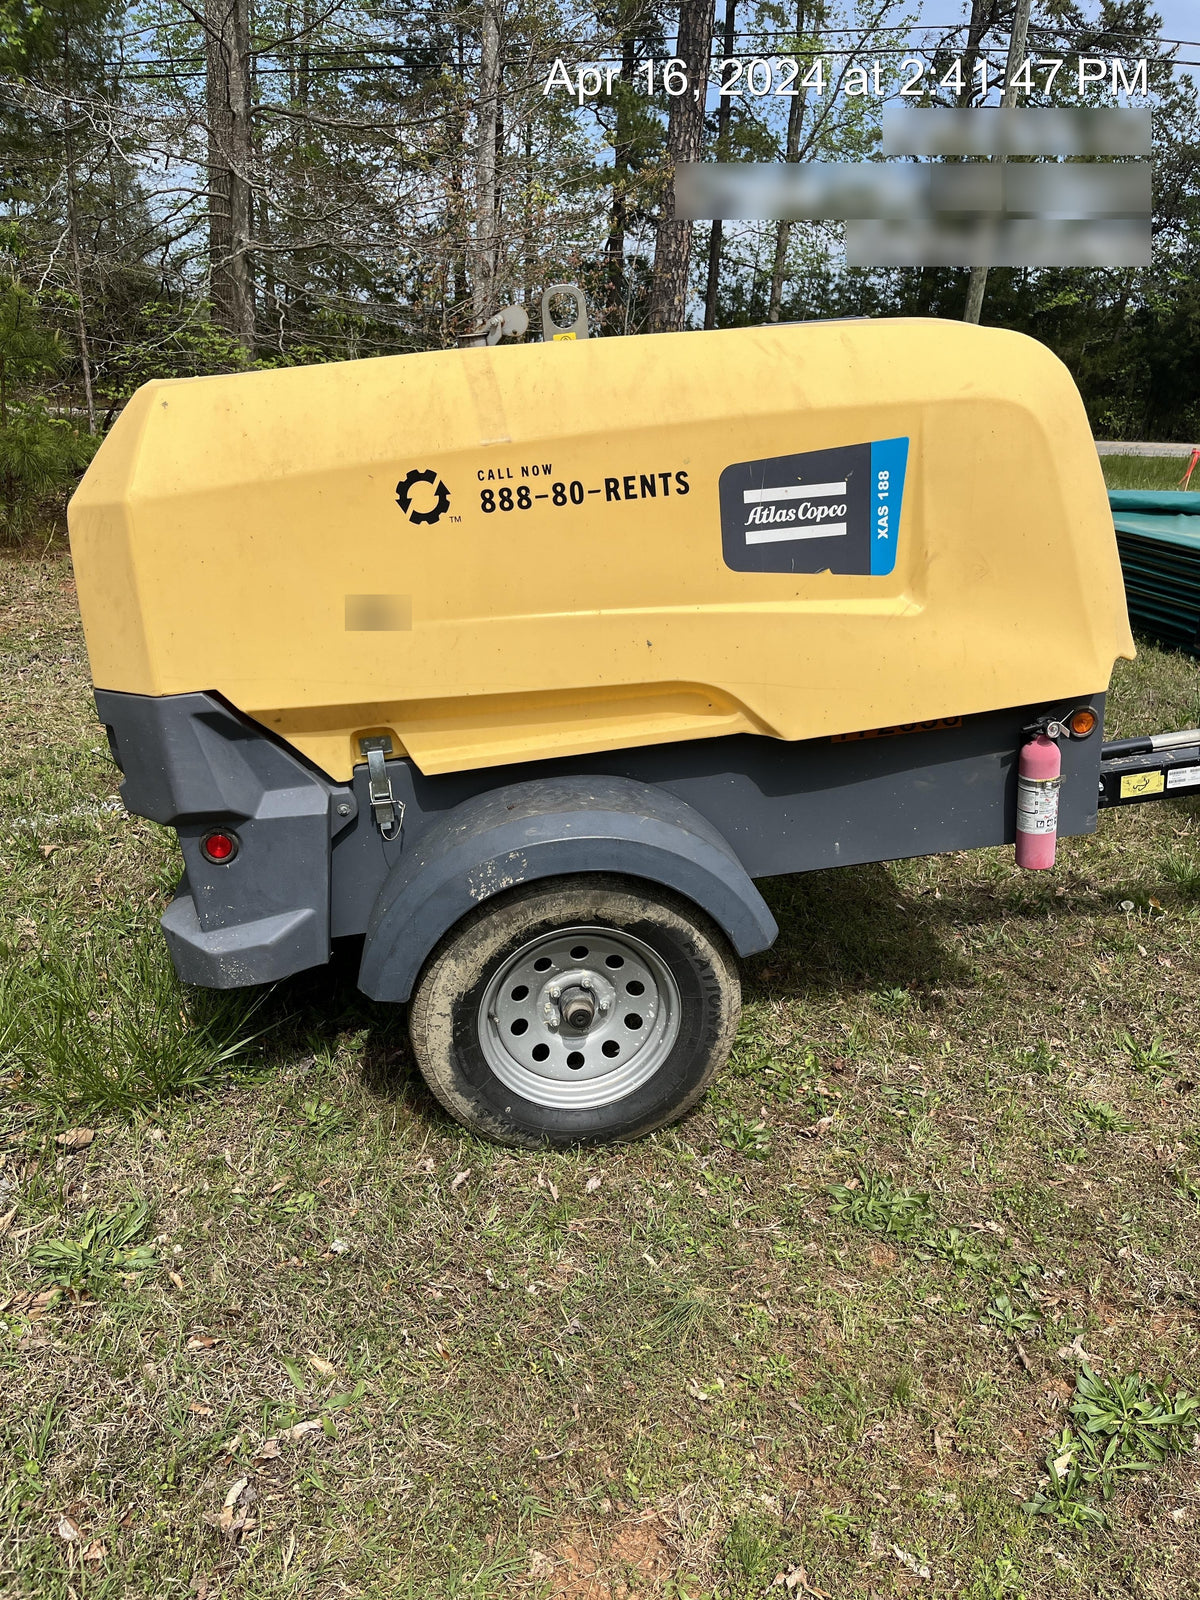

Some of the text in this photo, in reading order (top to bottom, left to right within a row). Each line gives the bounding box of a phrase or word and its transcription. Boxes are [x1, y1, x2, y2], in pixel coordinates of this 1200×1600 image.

[477, 463, 553, 482] CALL NOW
[480, 471, 690, 514] 888-80-RENTS
[877, 470, 890, 540] XAS 188
[744, 502, 847, 525] Atlas Copco
